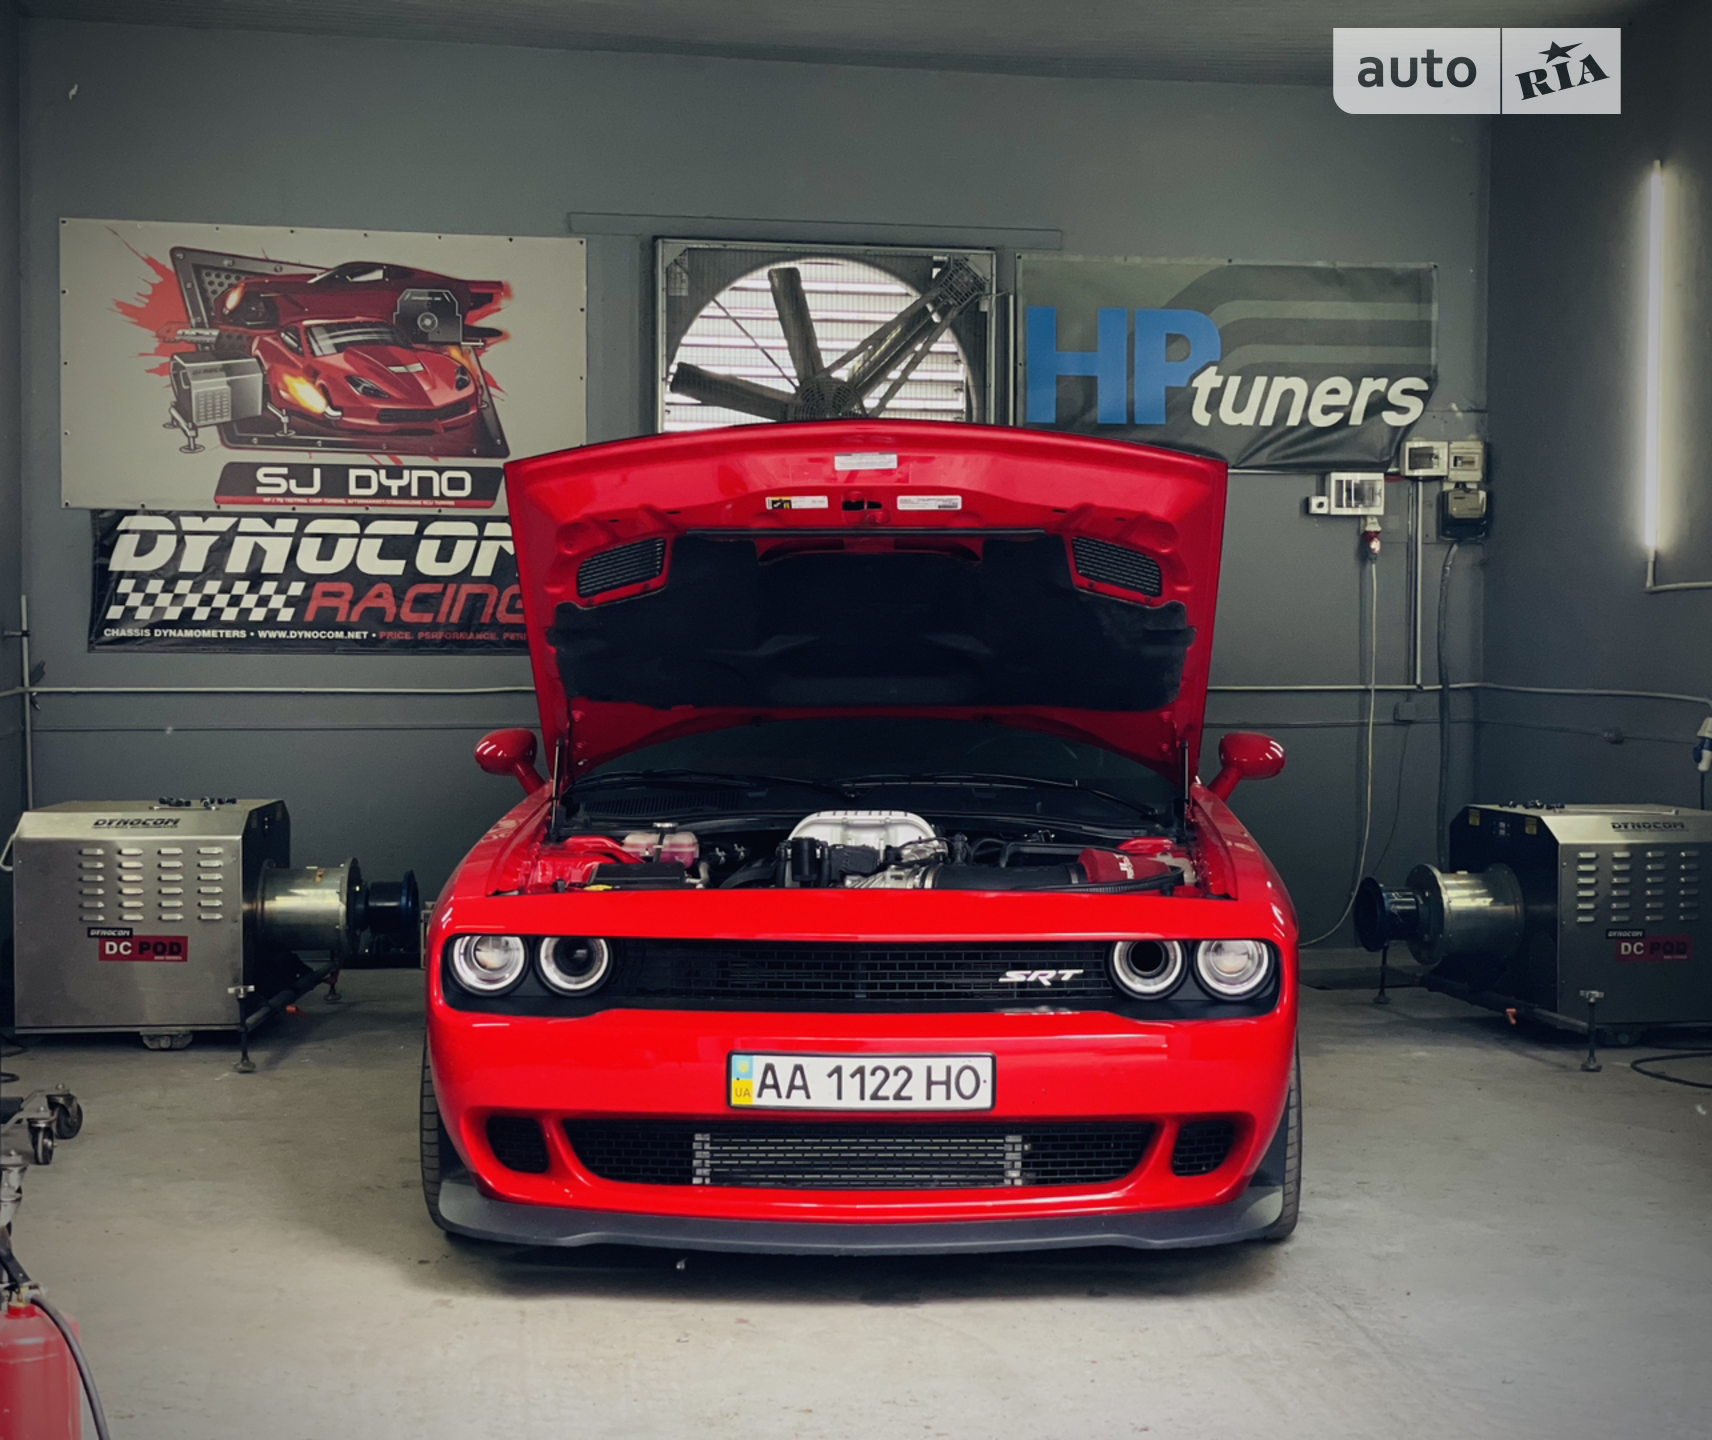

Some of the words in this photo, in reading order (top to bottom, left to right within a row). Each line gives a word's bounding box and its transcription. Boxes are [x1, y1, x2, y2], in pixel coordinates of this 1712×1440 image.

[1026, 307, 1221, 425] HP
[1191, 366, 1429, 428] tuners
[256, 466, 321, 495] SJ
[348, 468, 472, 497] DYNO
[304, 581, 526, 624] RACING
[103, 628, 151, 637] CHASSIS
[154, 628, 247, 638] DYNAMOMETERS
[258, 630, 368, 639] WWW.DYNOCOM.NET
[379, 631, 414, 640] PRICE.
[418, 631, 499, 640] PERFORMANCE.
[93, 818, 181, 826] DYNOCOM
[105, 941, 132, 955] DC
[139, 941, 182, 955] POD
[1620, 942, 1644, 955] DC
[1650, 941, 1687, 955] POD
[998, 969, 1084, 986] SRT
[757, 1062, 811, 1100] AA
[826, 1064, 913, 1101] 1122
[926, 1064, 981, 1101] HO
[735, 1087, 751, 1099] UA
